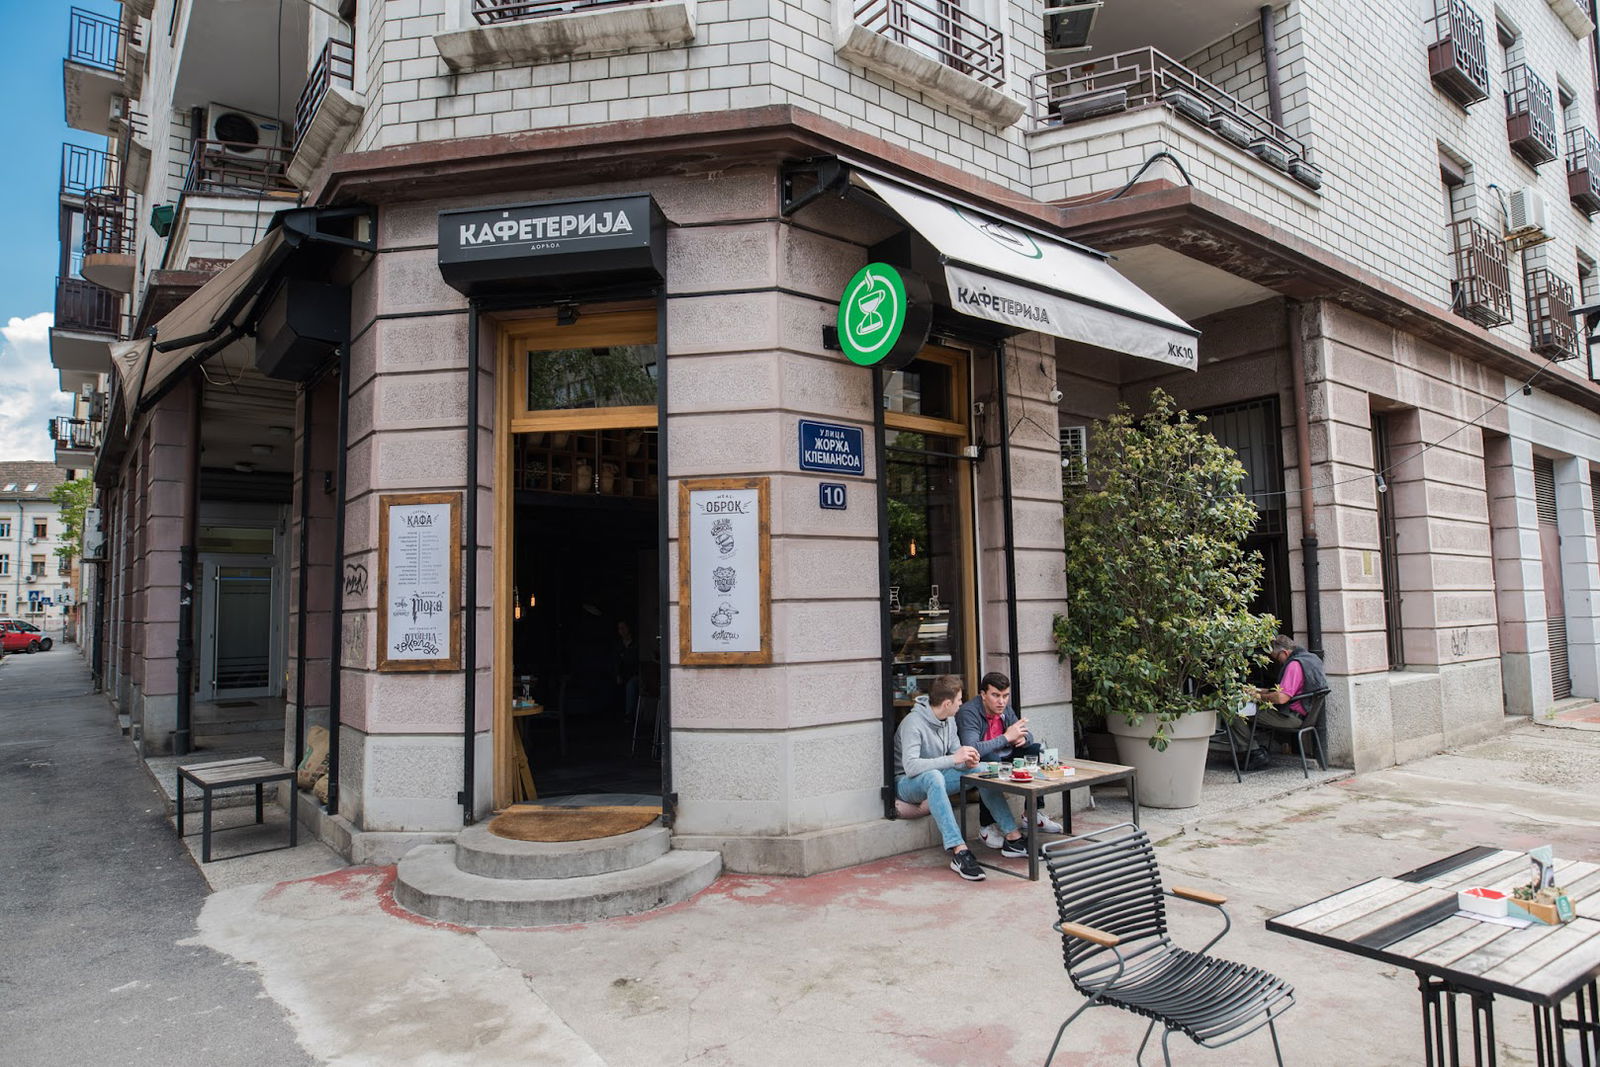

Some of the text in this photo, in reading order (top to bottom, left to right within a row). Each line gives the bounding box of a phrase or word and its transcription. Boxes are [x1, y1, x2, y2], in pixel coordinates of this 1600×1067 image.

[459, 211, 633, 246] КАФЕТЕРИЈА
[957, 286, 1194, 361] КАФЕТЕРИЈА ЖК10
[819, 429, 845, 439] УЛИЦА
[814, 437, 850, 453] ЖОРЖА
[804, 450, 860, 467] КЛЕМАНСОА
[824, 487, 844, 505] 10
[706, 500, 744, 514] ОБРОК
[407, 514, 432, 528] КАФА
